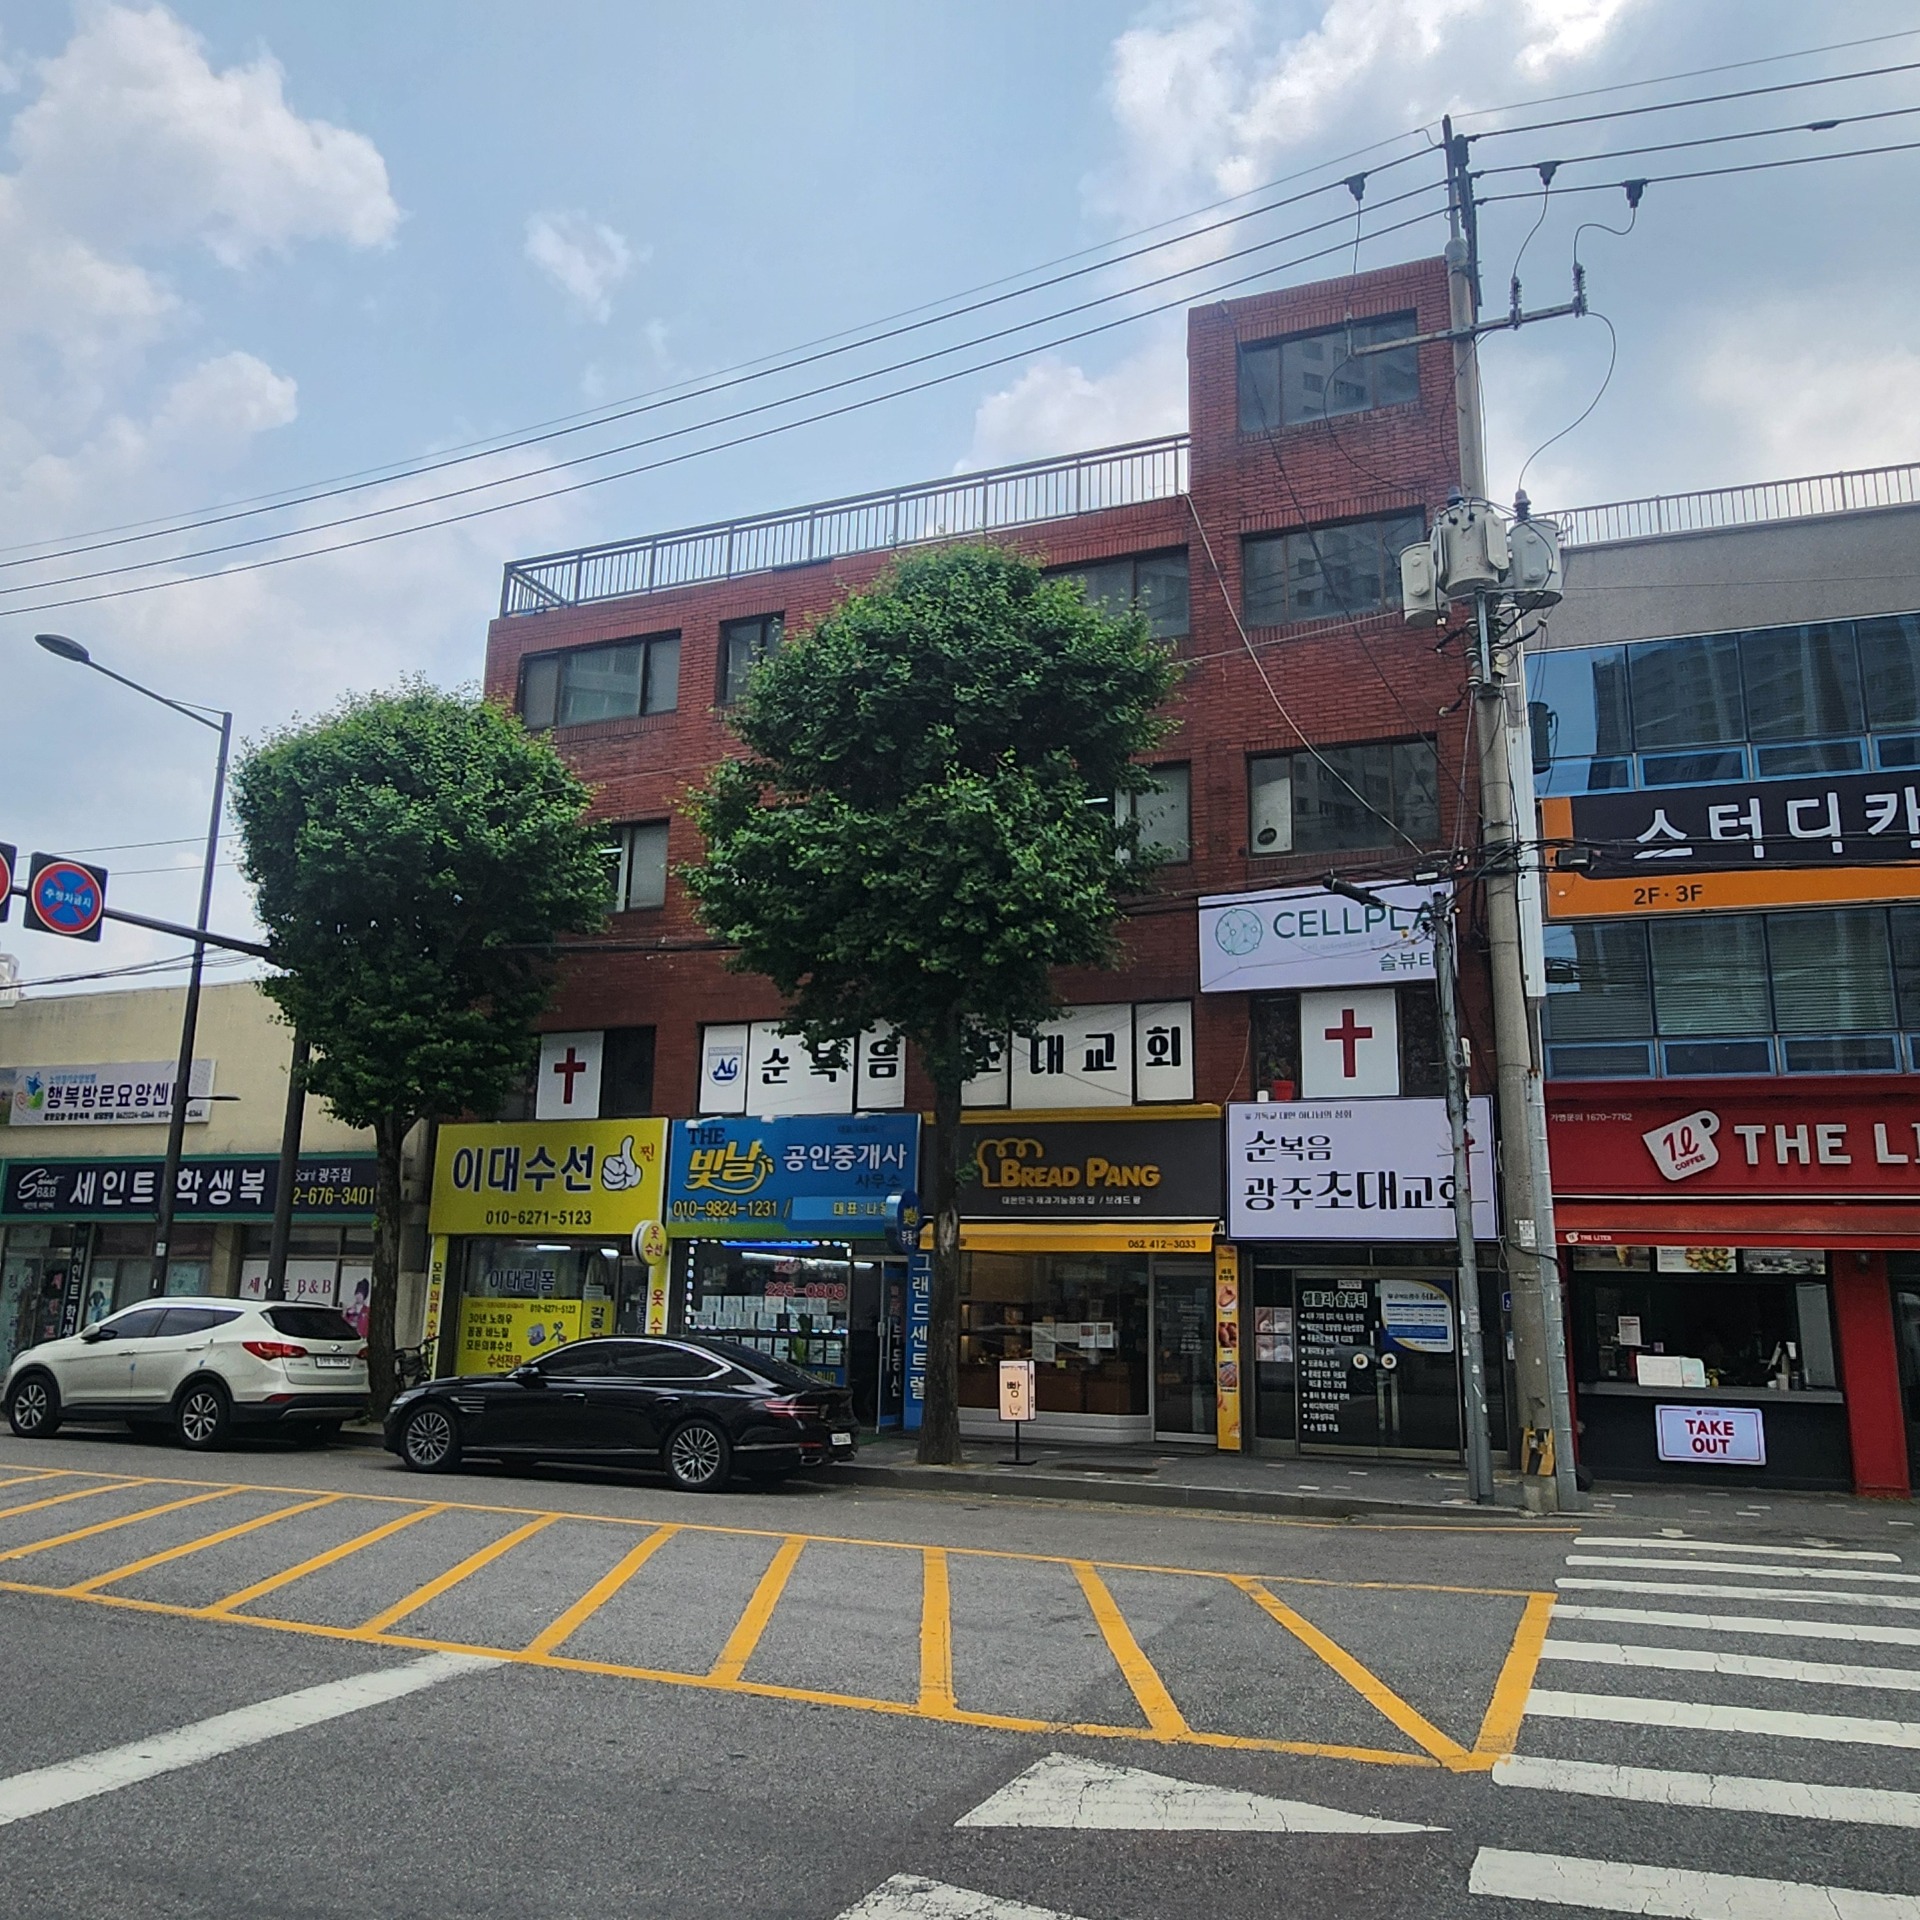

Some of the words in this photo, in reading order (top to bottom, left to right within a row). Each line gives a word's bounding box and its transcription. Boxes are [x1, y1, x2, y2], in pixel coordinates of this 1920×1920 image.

[47, 1081, 178, 1109] 행복방문요양센
[1586, 1112, 1633, 1122] 1670-7762
[688, 1128, 726, 1145] THE
[1734, 1124, 1852, 1165] THE
[1244, 1130, 1333, 1163] 순복음
[783, 1143, 908, 1172] 공인중개사
[1675, 1153, 1706, 1172] COFFEE
[318, 1167, 352, 1184] 광주점
[453, 1145, 595, 1193] 이대수선
[69, 1170, 156, 1206] 세인트
[175, 1168, 265, 1206] 학생복
[855, 1173, 901, 1188] 사무소
[486, 1210, 592, 1225] 010-6271-5123
[673, 1200, 778, 1217] 010-9824-1231
[1149, 1238, 1196, 1249] 412-3033
[489, 1269, 556, 1291] 이대리폼
[651, 1288, 665, 1307] 옷
[764, 1281, 848, 1302] 225-0808
[468, 1314, 488, 1324] 30년
[489, 1314, 513, 1325] 노하우
[909, 1253, 932, 1400] 그랜드센트럴
[1685, 1419, 1735, 1437] TAKE
[1691, 1437, 1731, 1454] OUT
